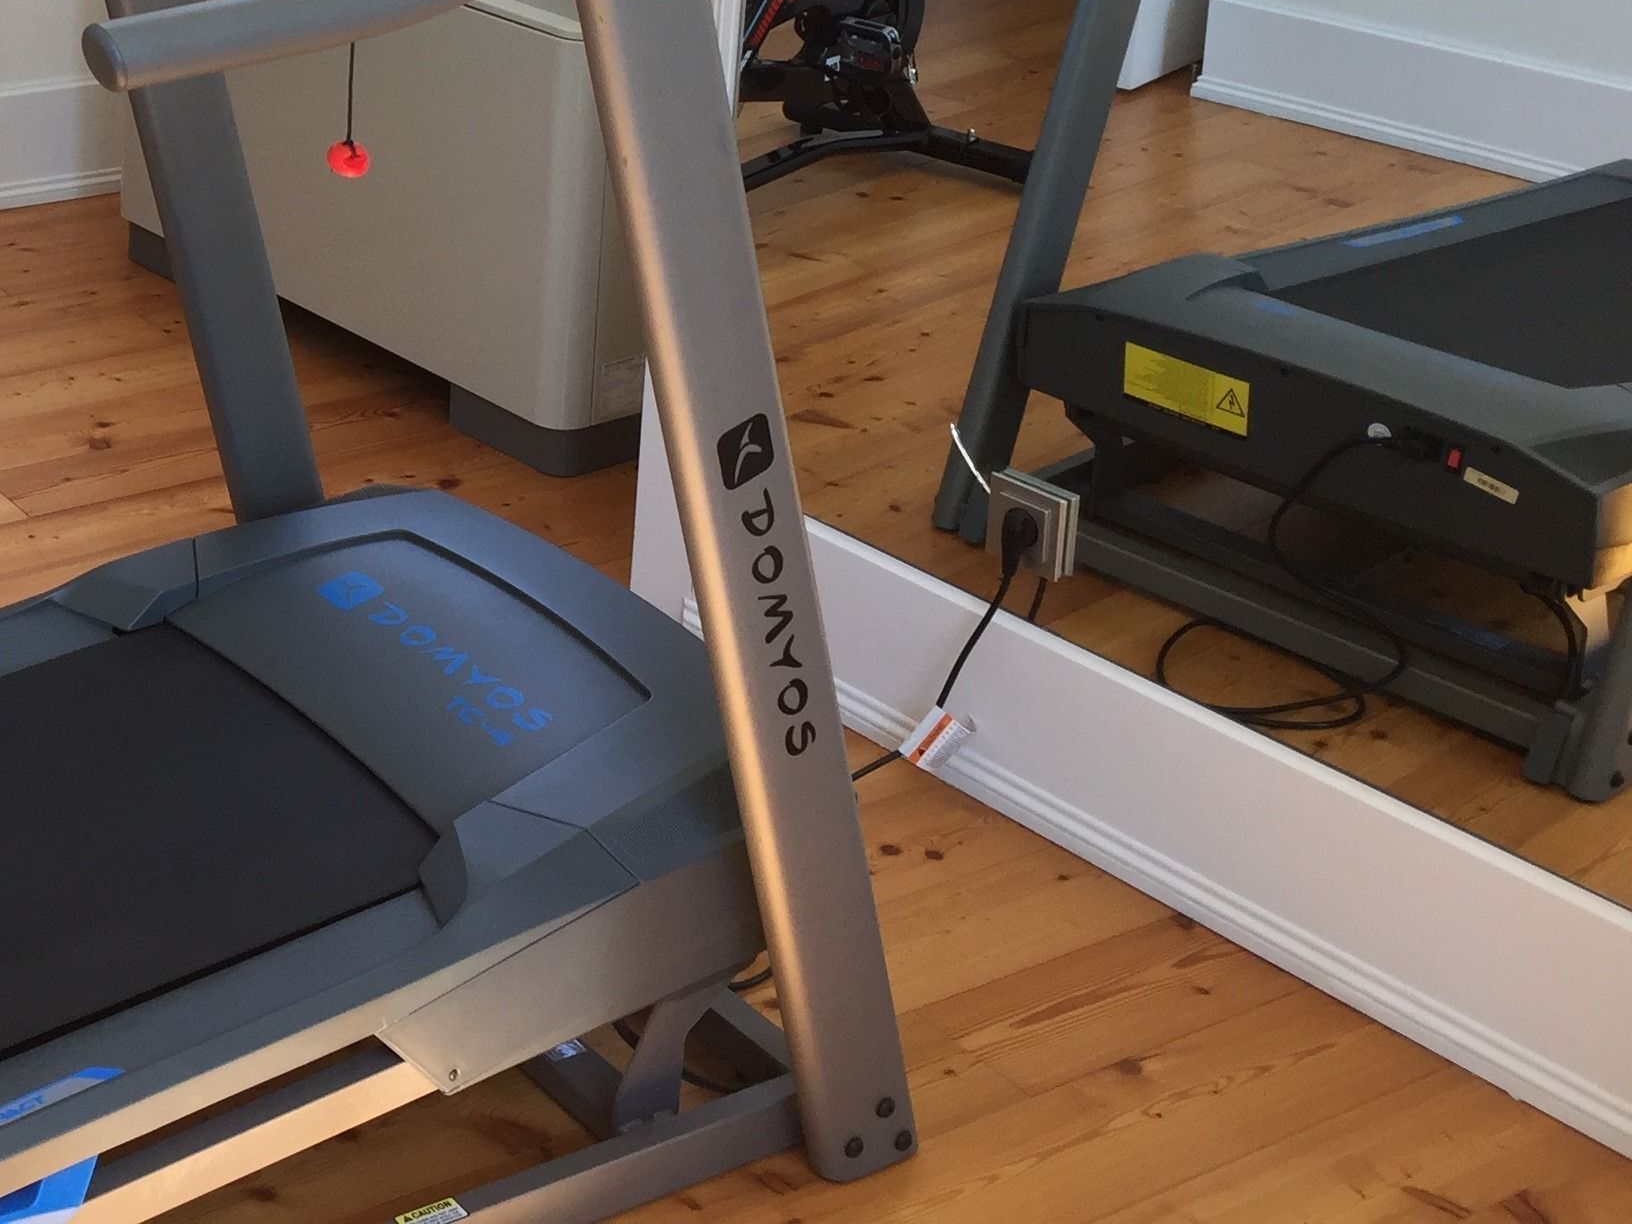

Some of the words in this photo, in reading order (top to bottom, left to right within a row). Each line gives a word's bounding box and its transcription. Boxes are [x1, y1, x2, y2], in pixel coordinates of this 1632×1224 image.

[368, 601, 552, 731] DOMYOS
[741, 487, 816, 757] DOMYOS
[410, 1200, 453, 1219] CAUTION
